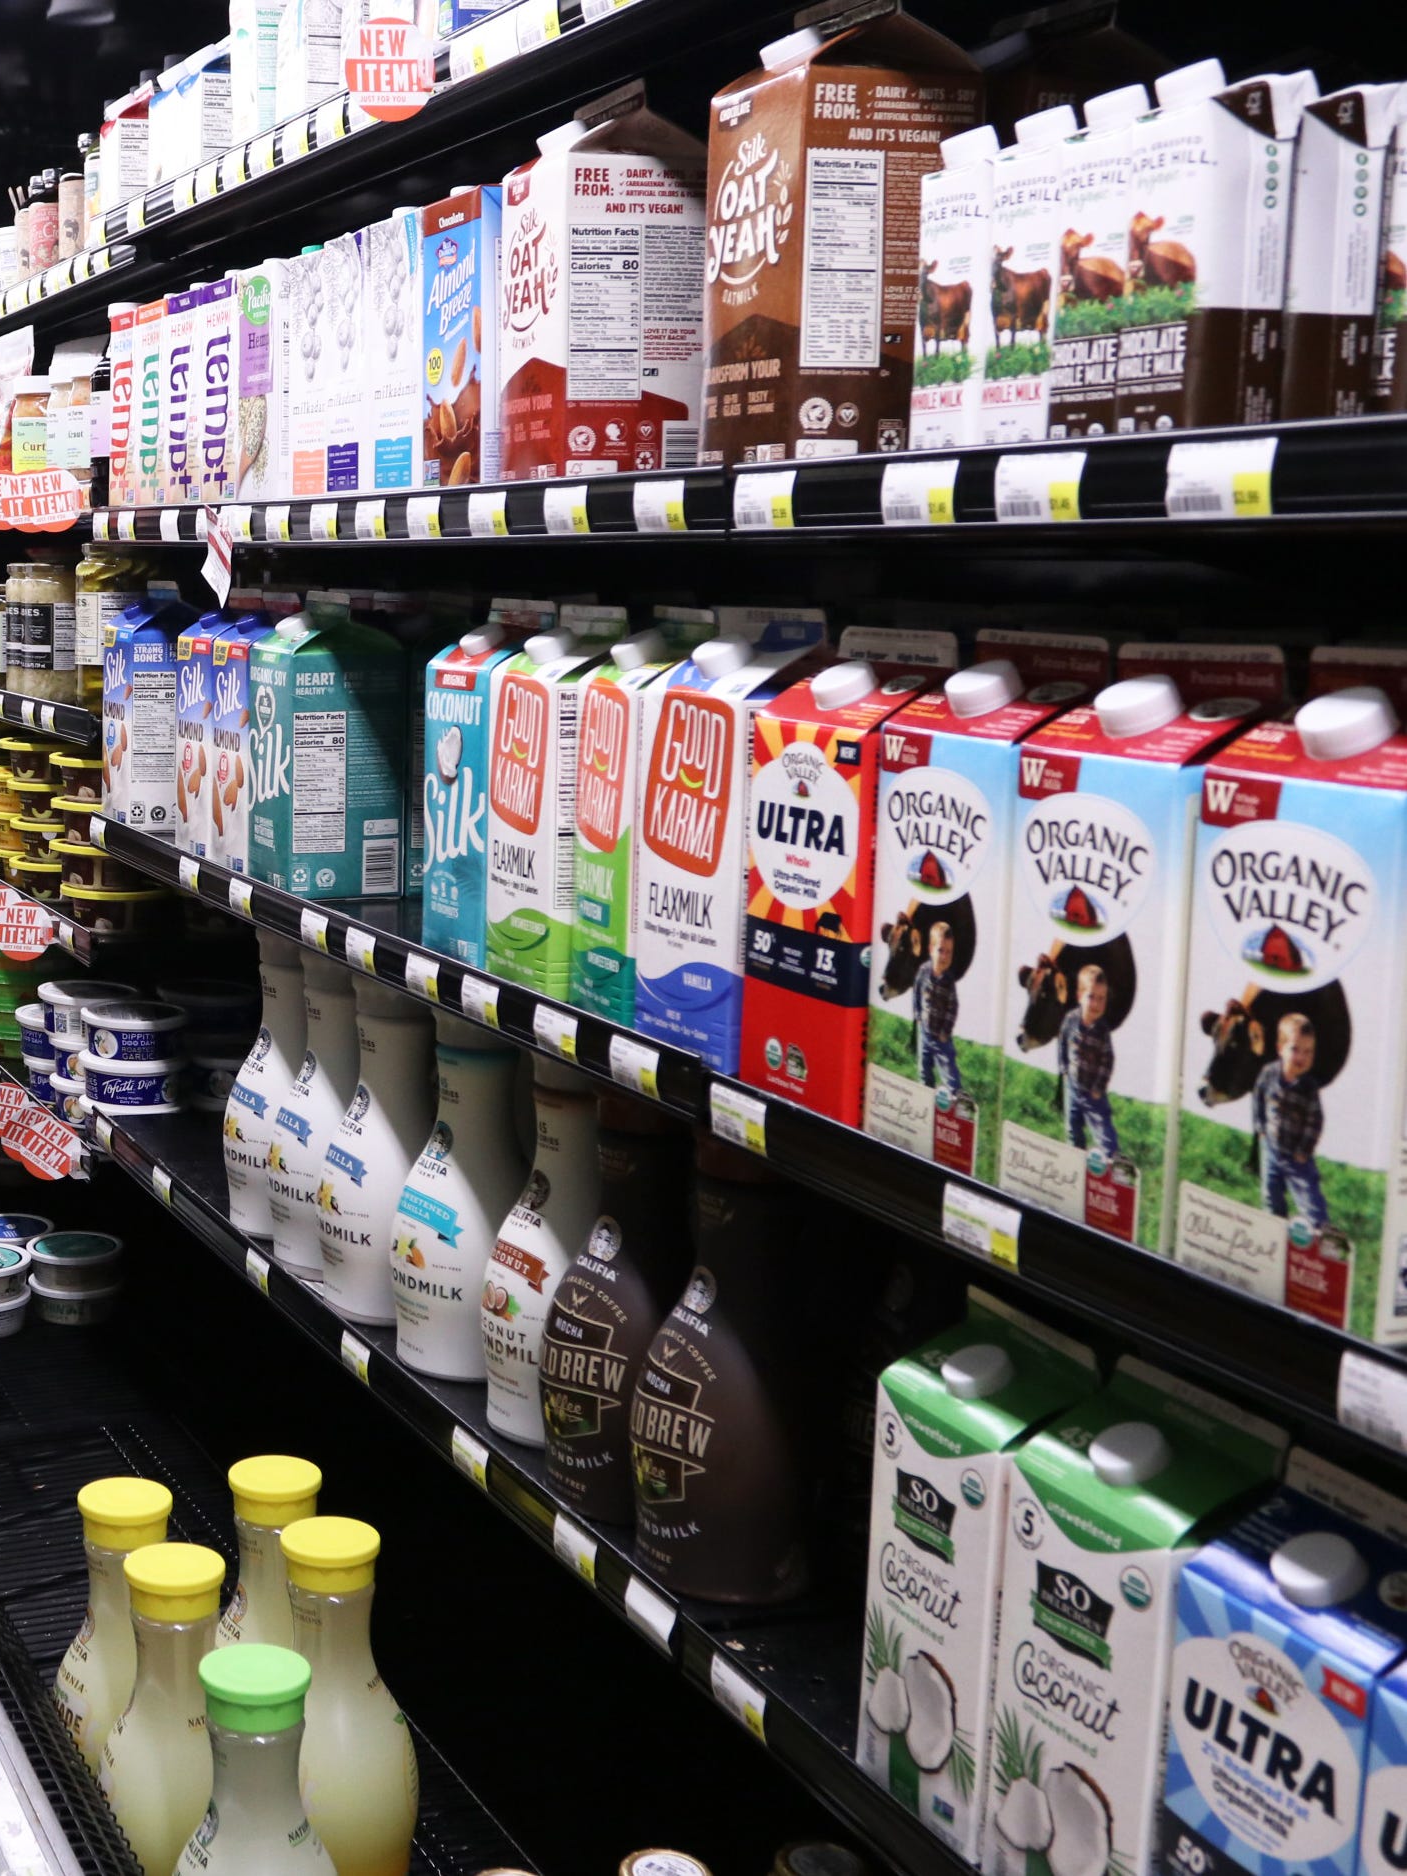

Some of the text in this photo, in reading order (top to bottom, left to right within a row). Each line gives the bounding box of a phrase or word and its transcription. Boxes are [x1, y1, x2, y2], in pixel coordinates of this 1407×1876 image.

[360, 29, 406, 56] NEW
[356, 62, 418, 92] ITEM!
[815, 83, 907, 102] FREE DAIRY
[814, 102, 861, 119] FROM:
[849, 127, 941, 143] AND IT'S VEGAN!
[735, 132, 768, 176] Silk
[813, 160, 878, 170] Nutrition Facts
[574, 168, 654, 183] FREE DAIRY
[574, 184, 615, 197] FROM:
[720, 149, 778, 221] OAT
[438, 212, 465, 229] Chocolate
[605, 203, 684, 214] AND IT'S VEGAN!
[518, 208, 540, 242] Silk
[571, 226, 640, 237] Nutrition Facts
[510, 221, 547, 279] OAT
[707, 202, 780, 284] YEAH
[426, 238, 475, 315] Almond
[571, 260, 640, 271] Calories 80
[246, 284, 271, 312] Pacific
[438, 281, 472, 336] Breeze
[503, 267, 550, 330] YEAH
[428, 357, 442, 371] 100
[751, 358, 781, 379] YOUR
[1084, 362, 1117, 386] MILK
[1153, 350, 1185, 376] MILK
[939, 387, 965, 409] MILK
[980, 380, 1042, 405] WHOLE MILK
[32, 473, 62, 494] NEW
[31, 492, 73, 517] ITEM!
[134, 646, 164, 654] STRONG
[134, 654, 164, 663] BONES
[104, 649, 127, 695] Silk
[250, 665, 287, 688] ORGANIC SOY
[296, 672, 336, 686] HEART
[178, 661, 205, 714] Silk
[213, 667, 243, 722] Silk
[295, 687, 326, 696] HEALTHY
[104, 700, 125, 721] ALMOND
[294, 713, 325, 721] Nutrition
[426, 691, 483, 726] COCONUT
[178, 719, 203, 743] ALMOND
[500, 681, 543, 768] GOOD
[583, 689, 624, 782] GOOD
[213, 727, 240, 753] ALMOND
[332, 736, 345, 746] 80
[660, 699, 727, 800] GOOD
[884, 734, 907, 762] W
[248, 724, 291, 812] Silk
[781, 751, 824, 775] ORGANIC
[786, 766, 821, 783] VALLEY
[1021, 756, 1047, 788] W
[494, 755, 539, 824] KARMA
[580, 767, 618, 840] KARMA
[1205, 778, 1240, 814] W
[423, 766, 487, 873] Silk
[650, 783, 715, 864] KARMA
[757, 800, 848, 857] ULTRA
[888, 790, 987, 842] ORGANIC
[895, 819, 974, 864] VALLEY
[1027, 818, 1150, 876] ORGANIC
[493, 839, 536, 881] FLAXMILK
[785, 852, 811, 869] Whole
[1036, 850, 1133, 899] VALLEY
[772, 868, 821, 889] Ultra-Filtered
[774, 879, 819, 900] Organic Milk
[1211, 848, 1368, 917] ORGANIC
[6, 907, 37, 925] NEW
[649, 881, 714, 930] FLAXMILK
[1223, 885, 1346, 942] VALLEY
[1, 926, 41, 945] ITEM!
[682, 971, 713, 992] VANILLA
[121, 1033, 155, 1041] DIPPITY
[121, 1053, 155, 1061] GARLIC
[101, 1078, 157, 1100] Tofutti Dips
[40, 1121, 75, 1150] NEW
[935, 1128, 962, 1148] Milk
[25, 1133, 66, 1170] ITEM!
[1087, 1190, 1120, 1216] Milk
[577, 1255, 617, 1283] CALIFIA
[1287, 1264, 1329, 1294] Milk
[597, 1289, 628, 1325] COFFEE
[555, 1316, 584, 1340] MOCHA
[559, 1351, 626, 1393] BREW
[687, 1344, 717, 1382] COFFEE
[646, 1370, 671, 1395] MOCHA
[645, 1406, 711, 1459] BREW
[885, 1422, 895, 1446] 5
[904, 1413, 962, 1455] unsweetened
[565, 1476, 586, 1493] FREE
[909, 1480, 939, 1513] SO
[1021, 1509, 1034, 1537] 5
[1046, 1498, 1123, 1551] unsweetened
[879, 1541, 962, 1630] Coconut
[898, 1548, 951, 1594] ORGANIC
[1054, 1573, 1092, 1613] SO
[1038, 1649, 1106, 1702] ORGANIC
[1228, 1640, 1304, 1699] ORGANIC
[1013, 1639, 1122, 1742] Coconut
[1235, 1659, 1294, 1711] VALLEY
[1184, 1676, 1337, 1820] ULTRA
[1211, 1762, 1295, 1829] Ultra-Filtered
[1224, 1756, 1310, 1822] Reduced Fat
[1212, 1780, 1260, 1820] Organic
[1263, 1812, 1289, 1840] Milk
